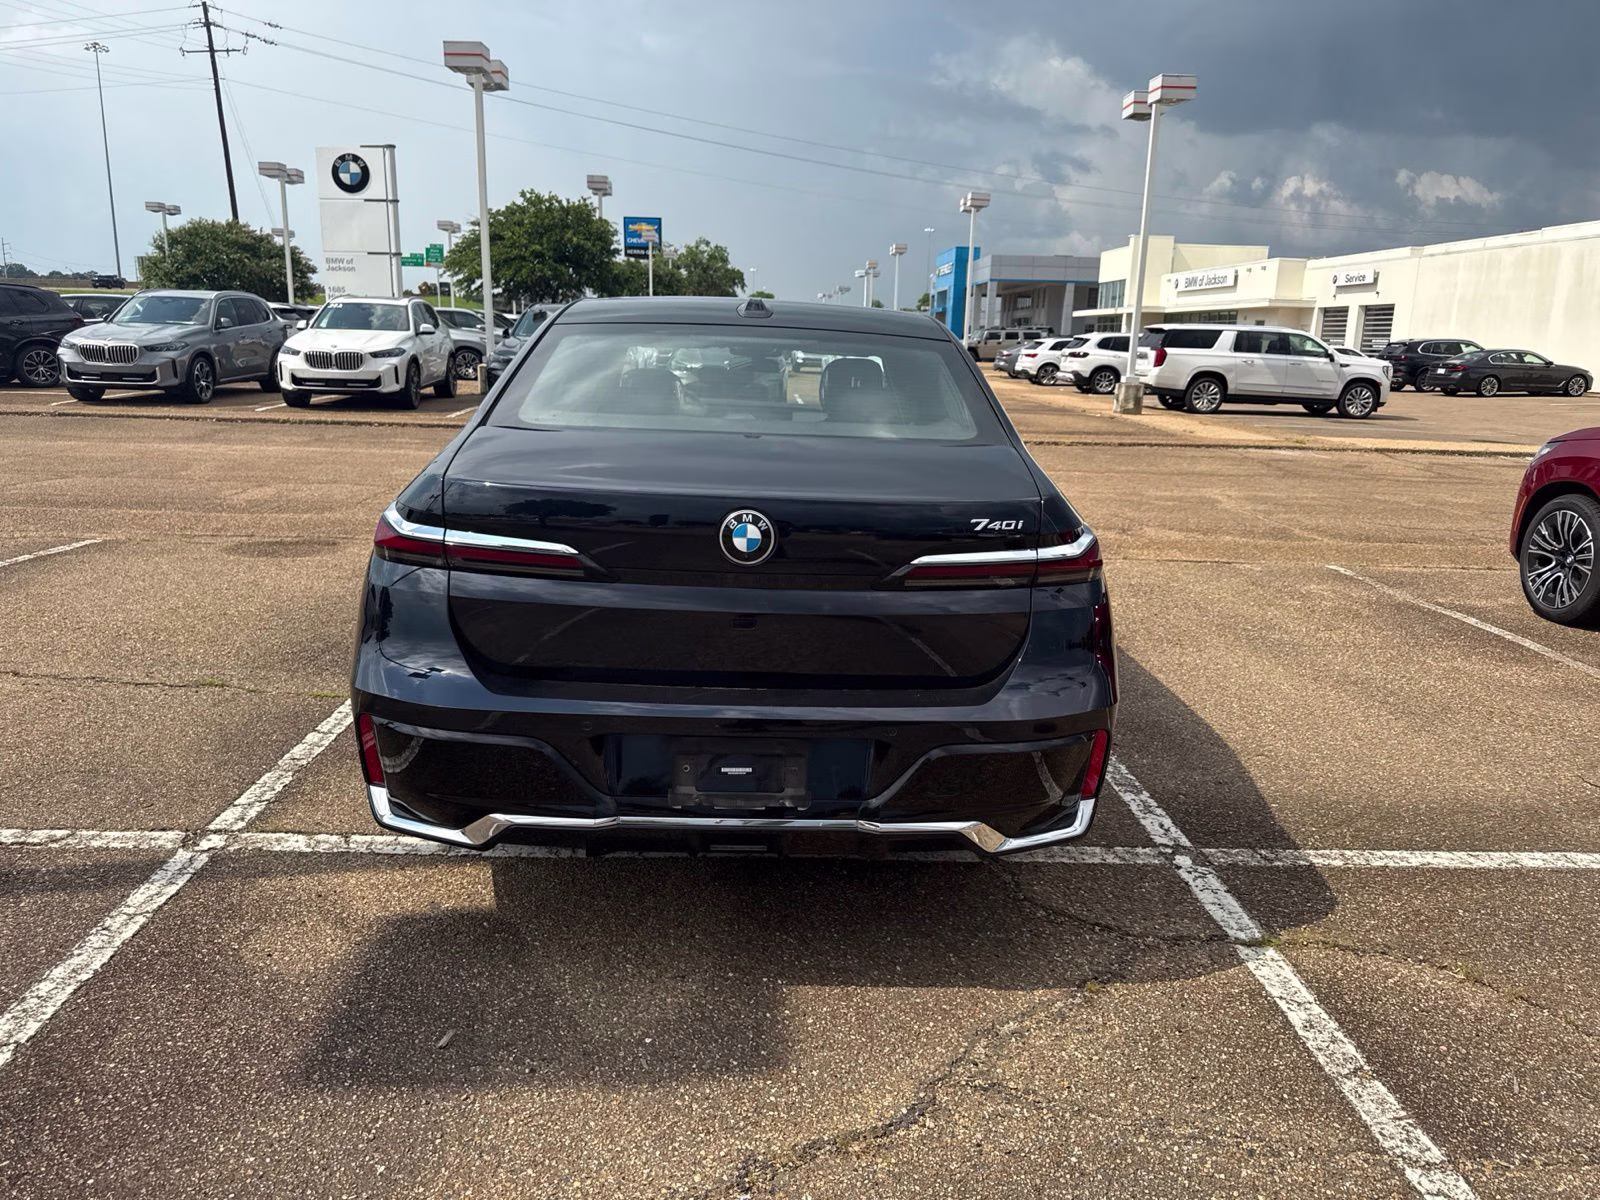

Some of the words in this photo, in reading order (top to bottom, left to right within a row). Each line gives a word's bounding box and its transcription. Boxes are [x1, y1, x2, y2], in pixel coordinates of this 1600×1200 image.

[325, 257, 345, 265] BMW
[345, 257, 354, 265] of
[1184, 276, 1198, 289] BMW
[1204, 273, 1228, 286] Jackson
[1345, 272, 1366, 283] Service
[727, 513, 769, 531] BMW
[970, 518, 1024, 531] 740i
